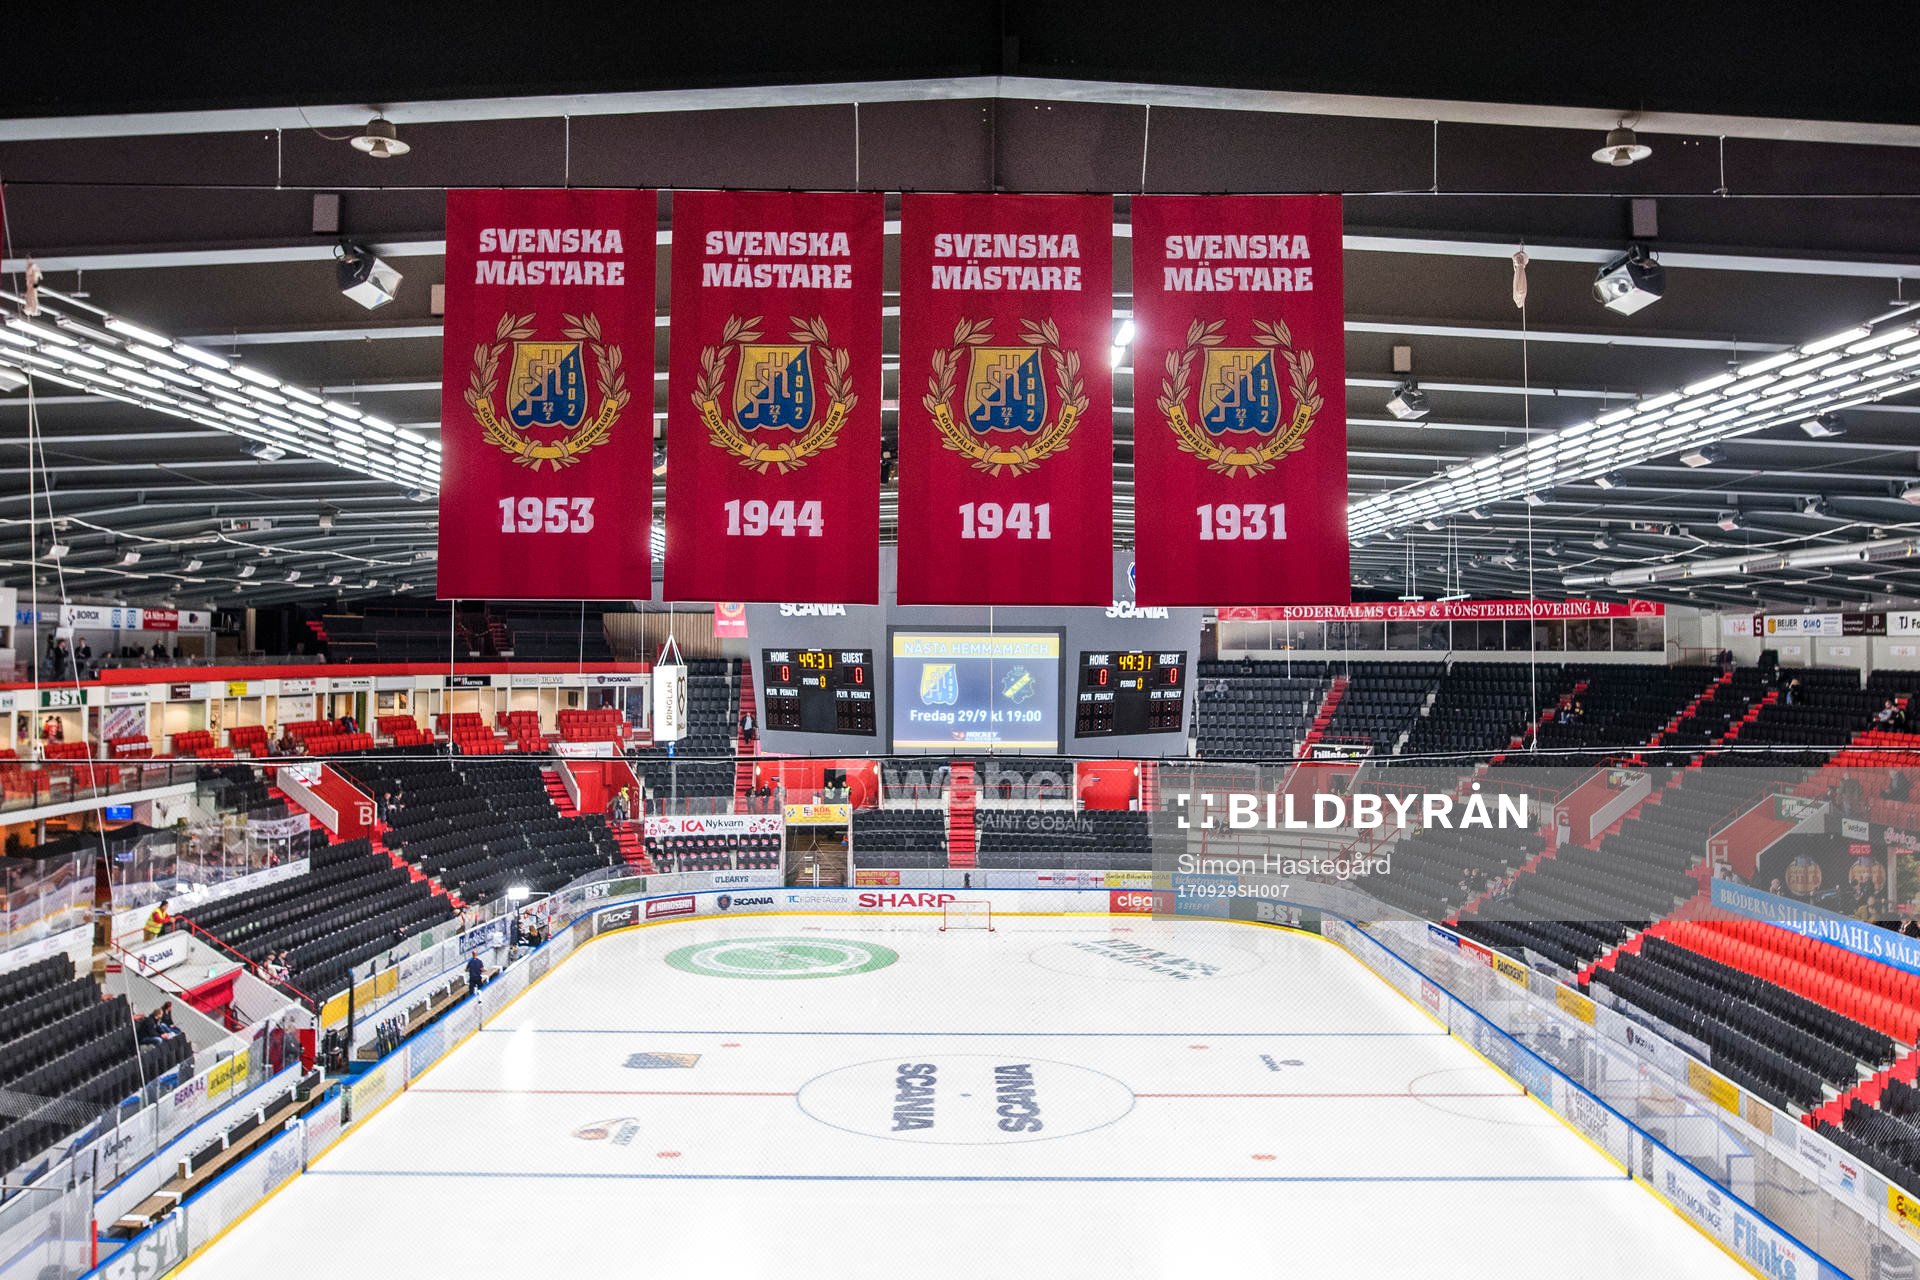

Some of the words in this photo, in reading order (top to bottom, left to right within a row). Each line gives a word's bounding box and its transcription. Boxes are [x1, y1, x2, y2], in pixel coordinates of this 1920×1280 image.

[479, 228, 624, 254] SVENSKA
[705, 231, 850, 257] SVENSKA
[934, 233, 1080, 259] SVENSKA
[1165, 235, 1310, 260] SVENSKA
[475, 255, 625, 286] MÄSTARE
[702, 258, 852, 289] MÄSTARE
[931, 260, 1082, 291] MÄSTARE
[1164, 262, 1313, 292] MÄSTARE
[568, 357, 576, 417] 1902
[795, 360, 803, 420] 1902
[1027, 361, 1036, 423] 1902
[1260, 362, 1269, 424] 1902
[480, 406, 518, 449] SÖDERTÄLJE
[575, 406, 615, 449] SPORTKLUBB
[707, 409, 744, 452] SÖDERTÄLJE
[802, 409, 841, 452] SPORTKLUBB
[939, 412, 977, 455] SÖDERTÄLJE
[1034, 412, 1074, 455] SPORTKLUBB
[1174, 413, 1211, 455] SÖDERTÄLJE
[1270, 412, 1308, 455] SPORTKLUBB
[499, 497, 595, 534] 1953
[724, 500, 824, 537] 1944
[959, 502, 1051, 540] 1941
[1196, 503, 1287, 541] 1931
[1388, 605, 1426, 616] GLAS
[1430, 605, 1440, 617] &
[1444, 602, 1591, 617] FÖNSTERRENOVERING
[1594, 602, 1610, 614] AB
[1777, 619, 1798, 627] BEIJER
[1899, 616, 1908, 629] TJ
[770, 652, 789, 662] HOME
[841, 652, 863, 663] GUEST
[904, 640, 947, 655] NÄSTA
[952, 642, 1048, 654] HEMMAMATCH
[799, 653, 833, 670] 49:31
[1089, 655, 1108, 665] HOME
[1119, 655, 1151, 671] 49:31
[1160, 654, 1179, 665] GUEST
[782, 666, 790, 681] 0
[803, 677, 819, 685] PERIOD
[820, 675, 826, 688] 0
[855, 667, 863, 683] 0
[1099, 669, 1107, 685] 0
[1120, 680, 1136, 688] PERIOD
[1137, 677, 1143, 690] 0
[1170, 668, 1177, 683] 0
[49, 690, 80, 705] BST
[766, 688, 778, 696] PLYR
[780, 688, 798, 696] PENALTY
[850, 691, 871, 699] PENALTY
[1080, 693, 1092, 701] PLYR
[1095, 693, 1114, 701] PENALTY
[1151, 691, 1161, 699] PLYR
[1164, 690, 1181, 698] PENALTY
[910, 709, 954, 724] Fredag
[958, 709, 987, 722] 29/9
[992, 710, 1003, 721] kl
[1007, 710, 1042, 722] 19:00
[360, 806, 373, 825] B
[681, 820, 705, 832] ICA
[706, 819, 744, 830] Nykvarn
[975, 813, 1023, 829] SAINT
[1026, 814, 1094, 833] GOBAIN
[733, 895, 774, 906] SCANIA
[859, 893, 956, 908] SHARP
[1117, 892, 1163, 907] clean
[1257, 901, 1302, 927] BST
[1720, 889, 1776, 918] BRÖDERNA
[1778, 904, 1882, 957] SILJENDAHLS
[148, 948, 173, 965] SCANIA
[891, 1063, 938, 1132] SCANIA
[994, 1063, 1044, 1133] SCANIA
[1733, 1211, 1797, 1280] Flinks
